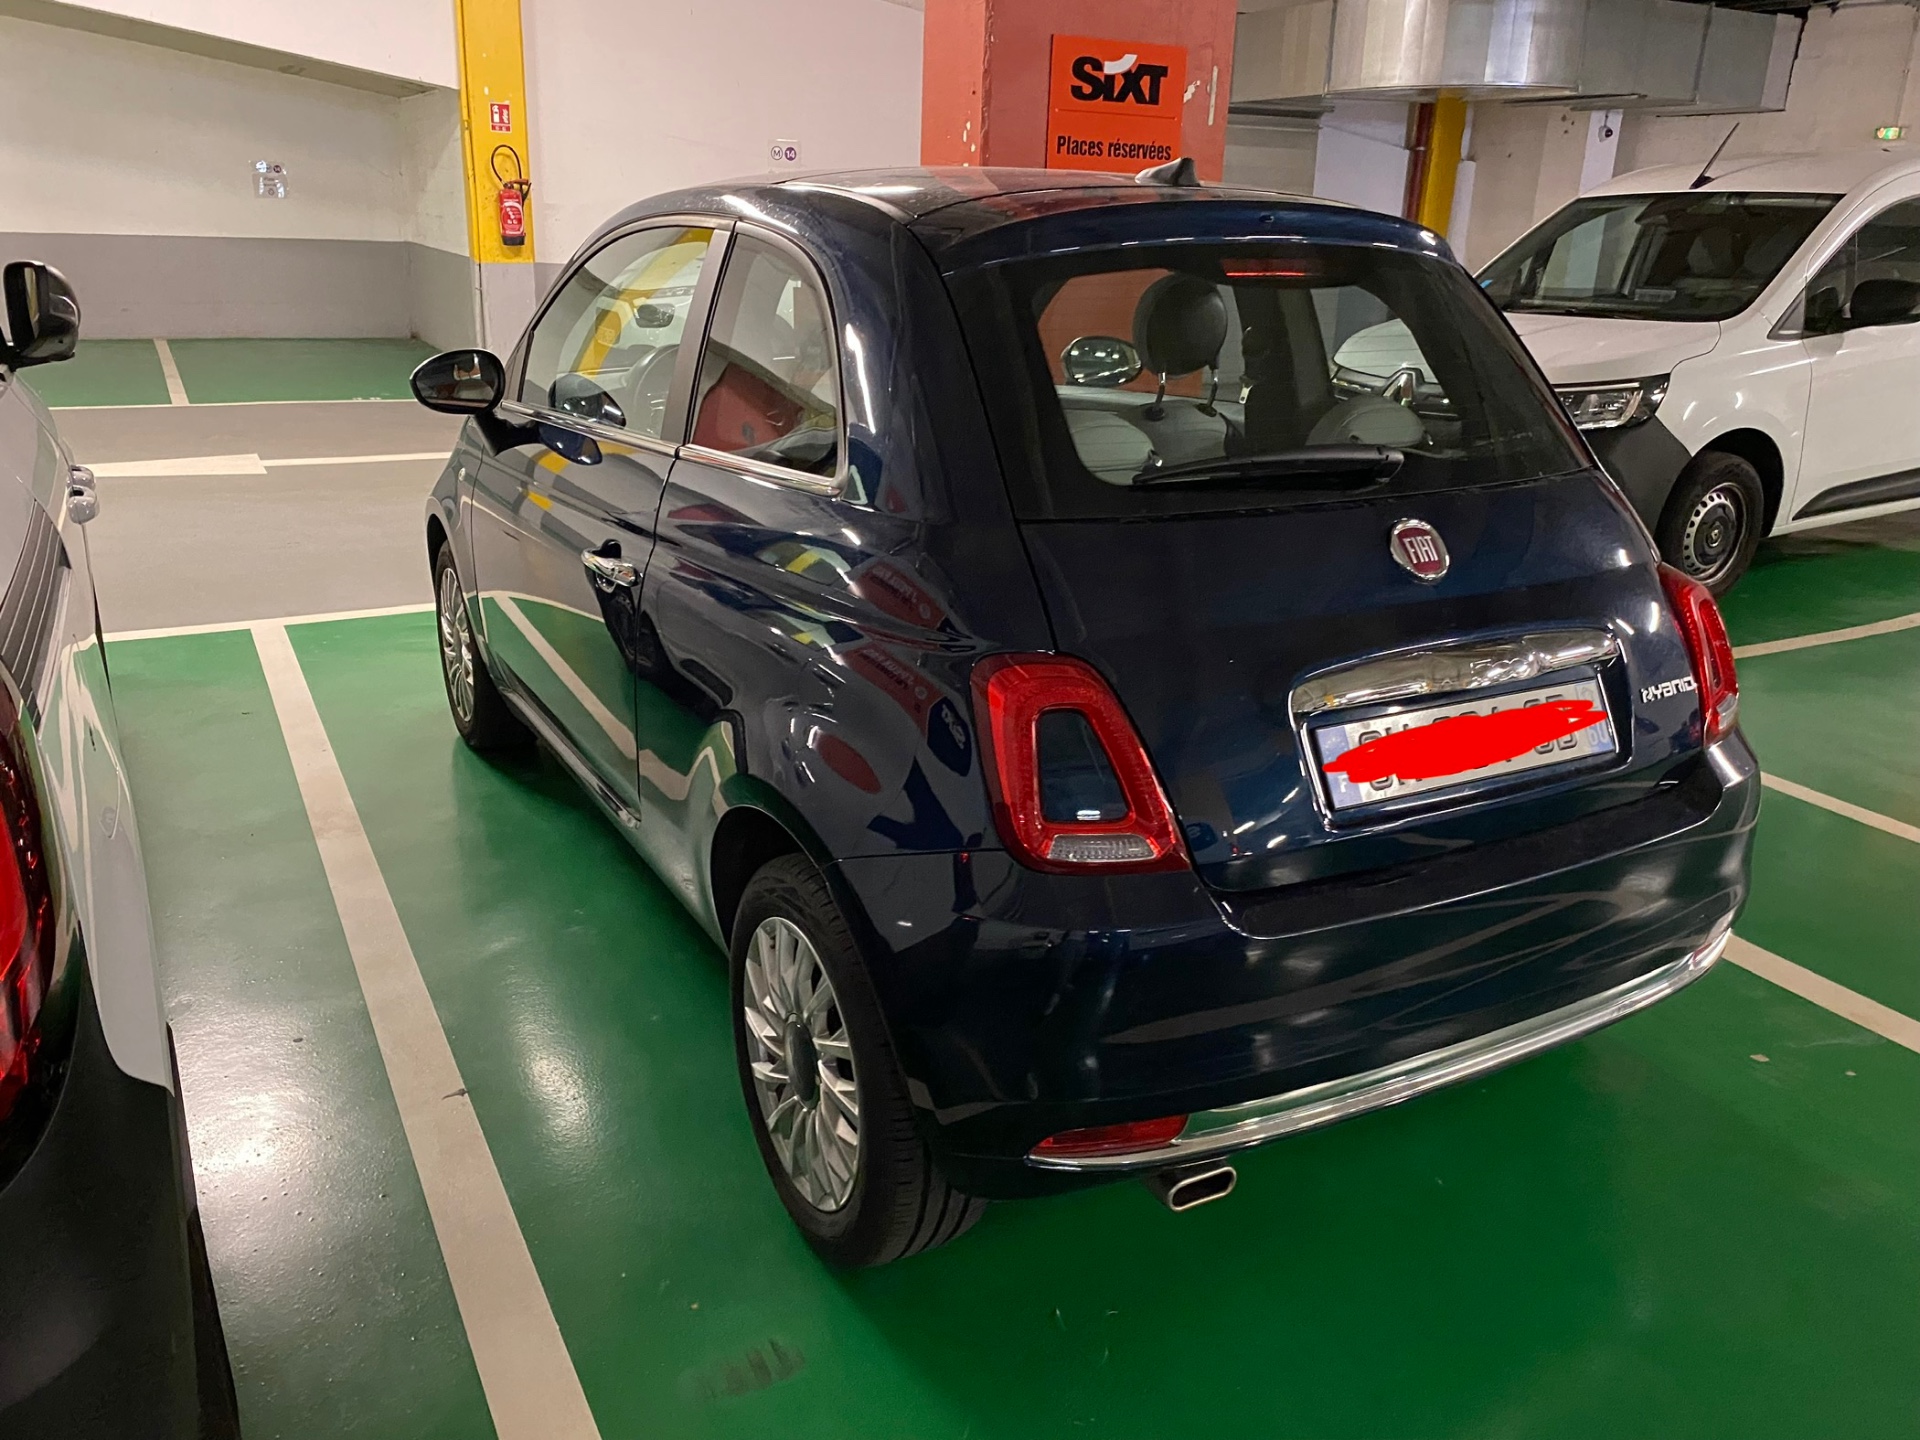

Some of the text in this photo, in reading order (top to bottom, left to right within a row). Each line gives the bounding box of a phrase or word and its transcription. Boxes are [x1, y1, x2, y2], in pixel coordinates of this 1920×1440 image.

[1056, 135, 1172, 161] Places réservées
[1402, 535, 1439, 564] FIAT
[1641, 675, 1696, 704] HYBRID
